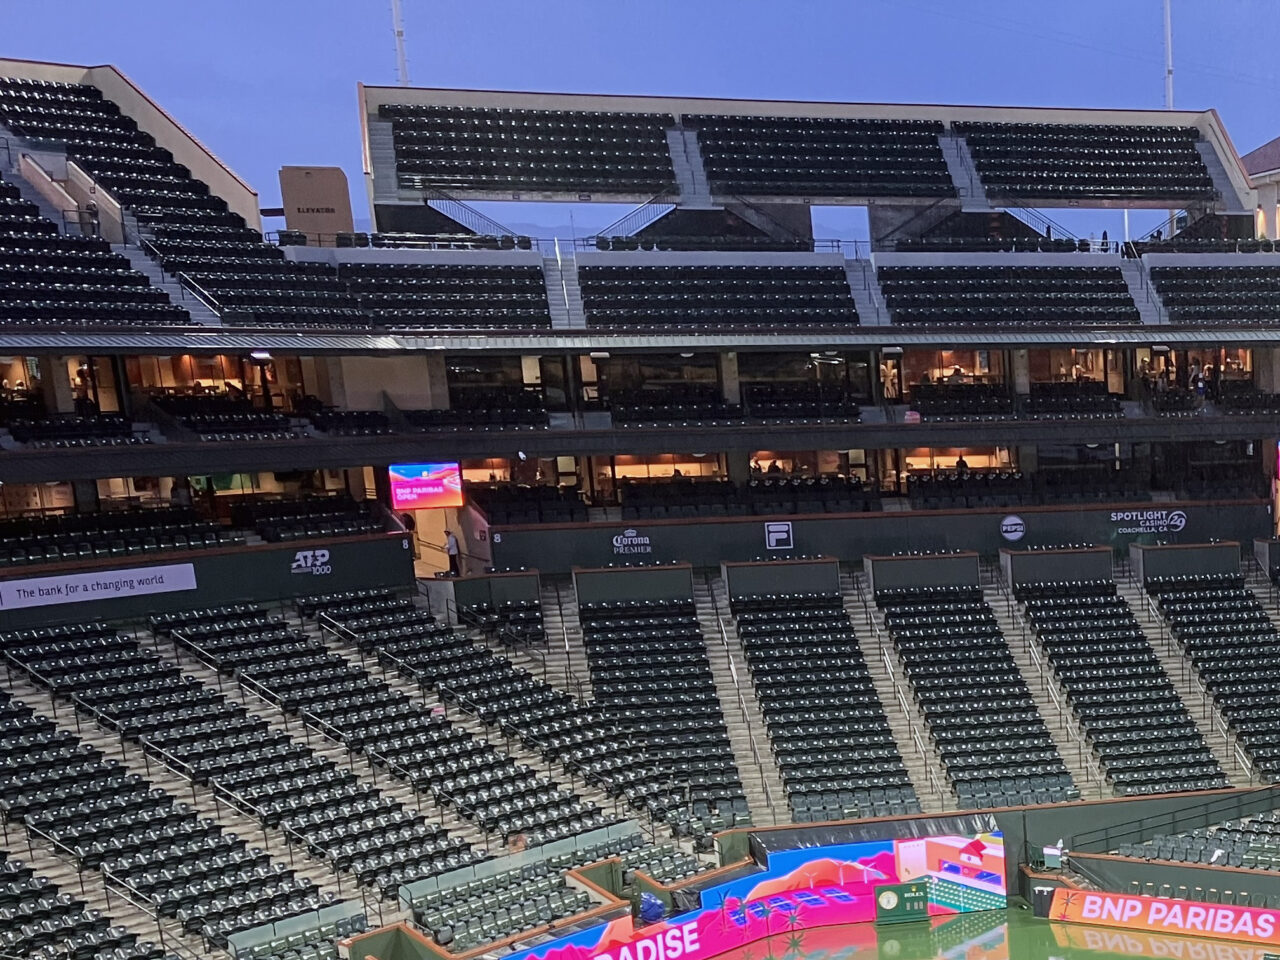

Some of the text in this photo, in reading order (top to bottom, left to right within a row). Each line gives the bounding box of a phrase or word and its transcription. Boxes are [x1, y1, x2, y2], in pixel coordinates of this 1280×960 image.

[1110, 511, 1168, 521] SPOTLIGHT
[1140, 519, 1168, 527] CASINO
[493, 533, 501, 543] 8
[612, 535, 650, 547] Corona
[402, 539, 409, 549] 8
[613, 546, 652, 555] PREMIER
[290, 550, 330, 569] ATP
[312, 565, 332, 575] 1000
[16, 575, 165, 600] The bank for a changing world
[1082, 895, 1143, 921] BNP
[1147, 902, 1275, 938] PARIBAS
